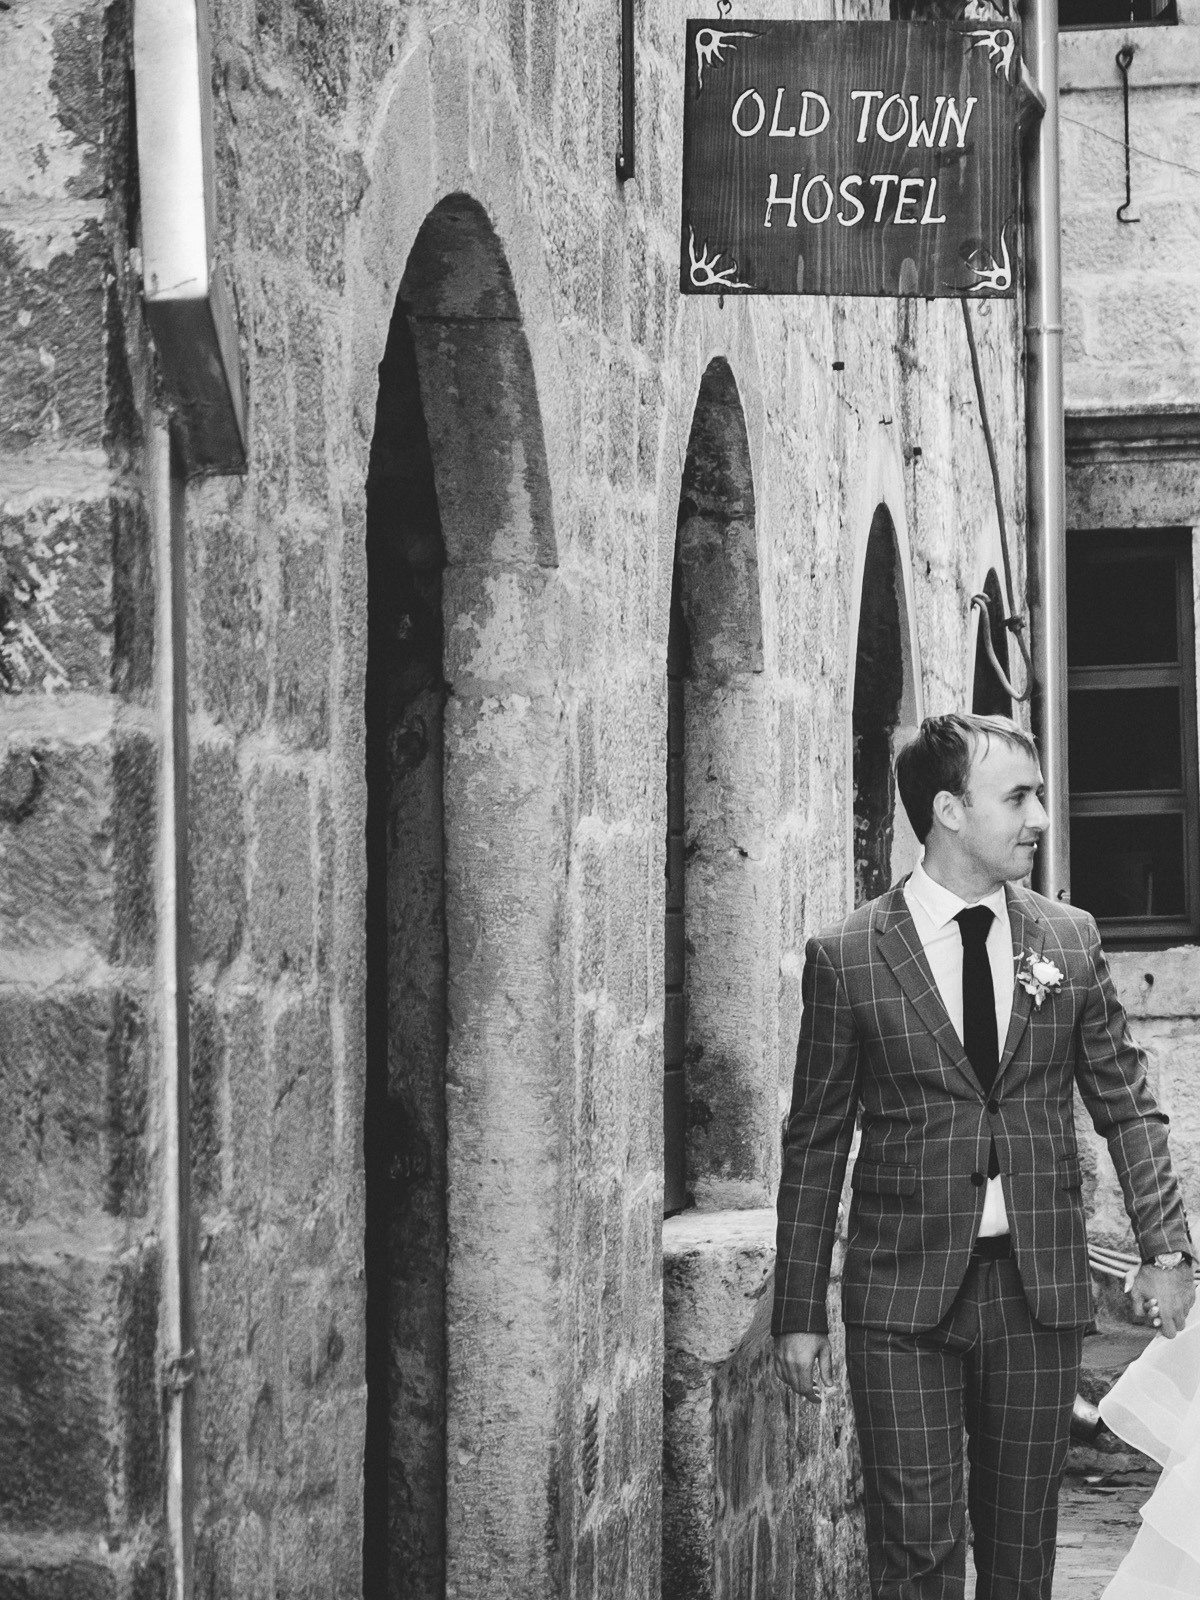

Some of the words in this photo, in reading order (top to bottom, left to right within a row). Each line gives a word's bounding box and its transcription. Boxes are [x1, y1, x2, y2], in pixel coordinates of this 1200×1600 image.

[731, 87, 831, 138] OLD
[850, 90, 978, 148] TOWN
[763, 173, 947, 228] HOSTEL
